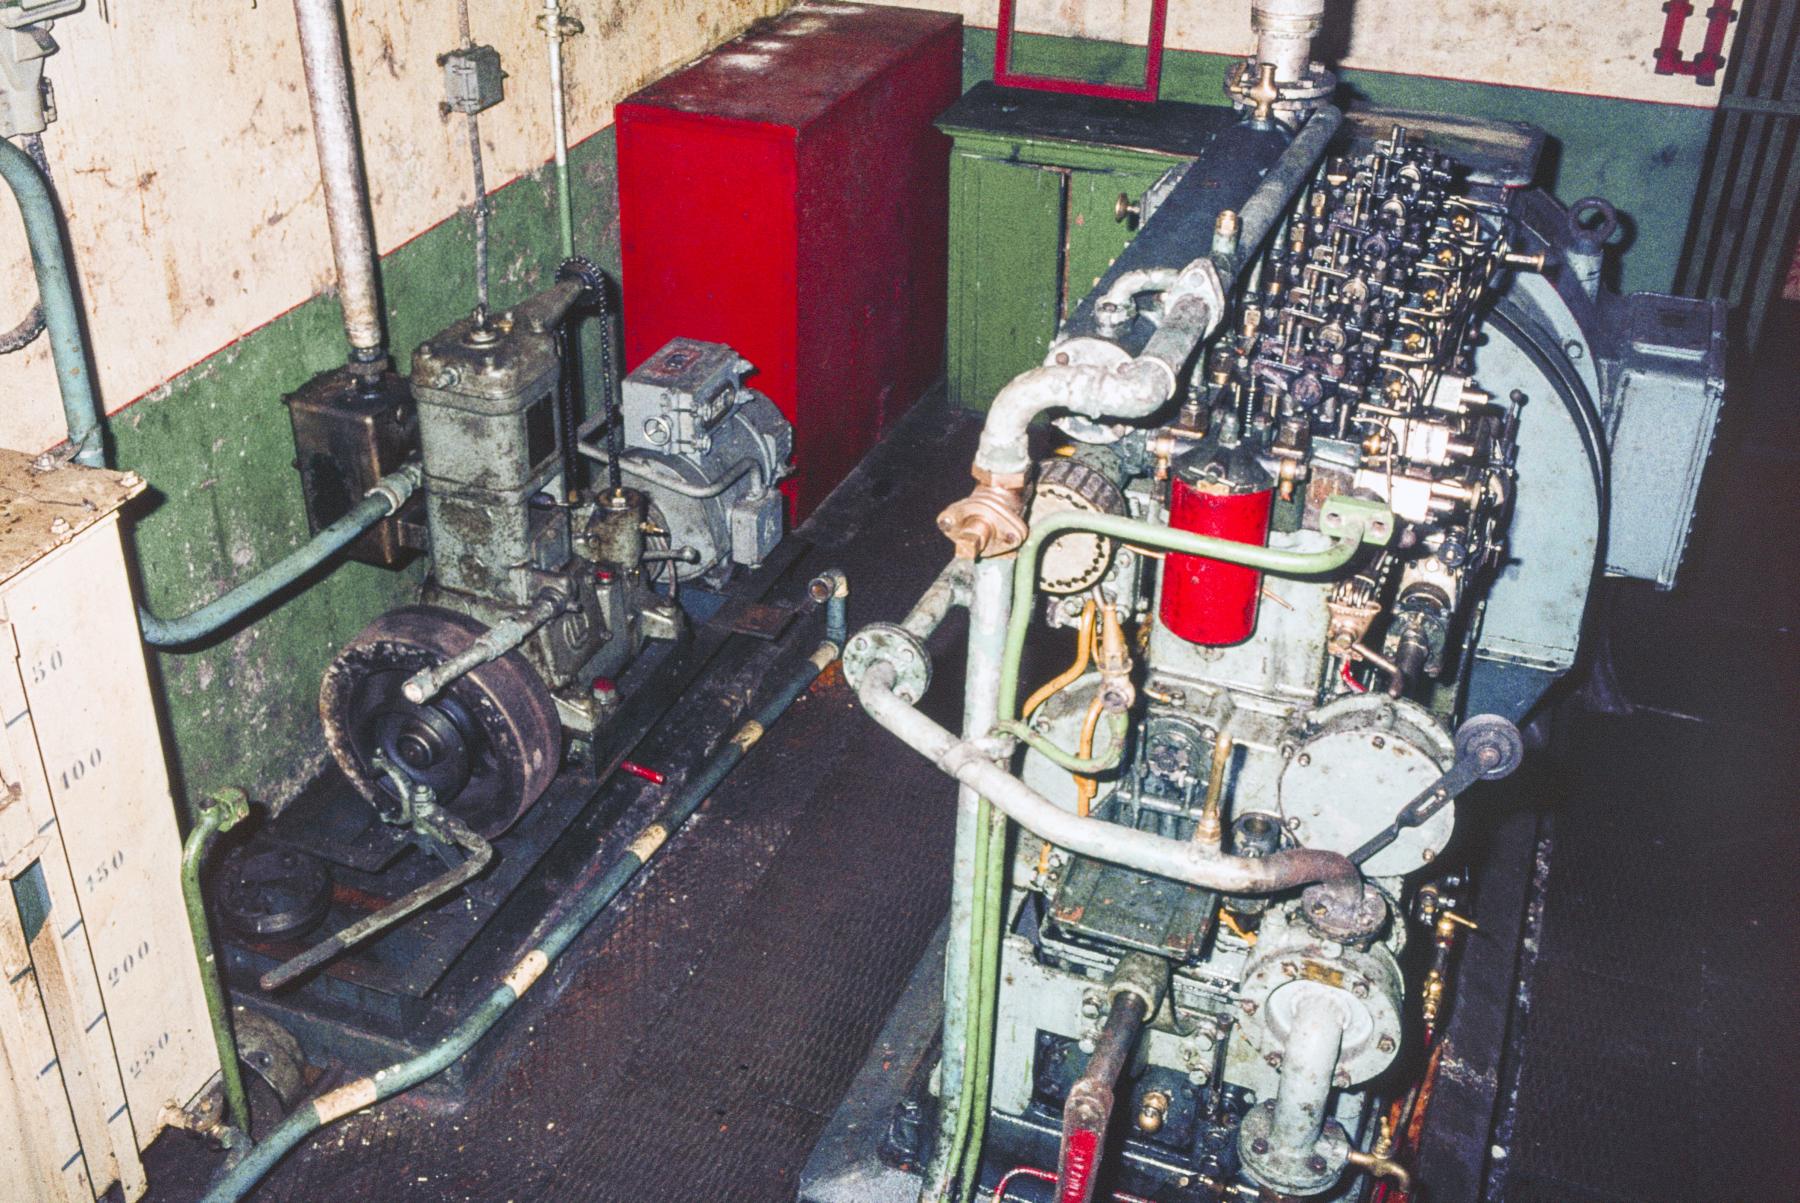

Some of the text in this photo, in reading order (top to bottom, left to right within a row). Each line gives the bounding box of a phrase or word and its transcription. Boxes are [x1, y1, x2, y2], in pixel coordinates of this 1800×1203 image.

[32, 649, 63, 684] 50
[61, 747, 102, 790] 100
[86, 849, 124, 892] 150
[108, 940, 149, 987] 200
[129, 1031, 169, 1079] 250
